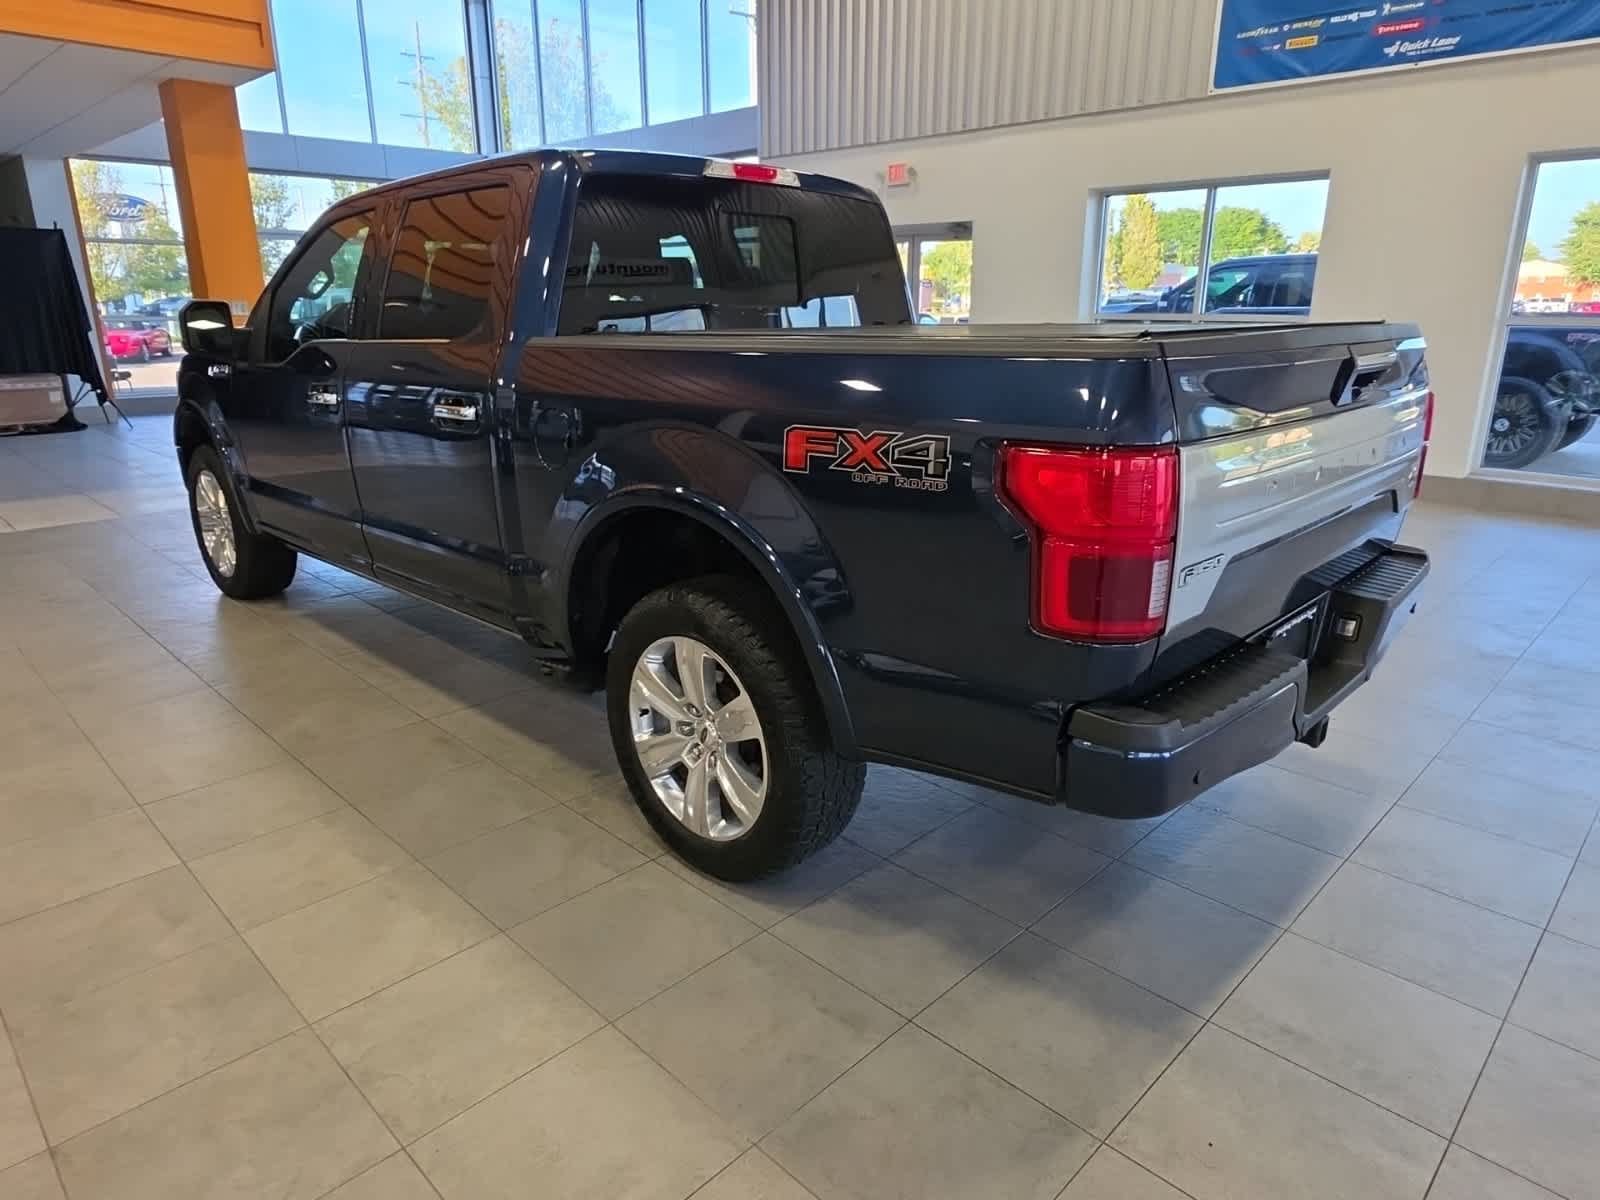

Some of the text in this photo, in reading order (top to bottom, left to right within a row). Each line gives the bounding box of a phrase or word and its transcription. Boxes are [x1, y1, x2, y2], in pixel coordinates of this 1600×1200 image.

[1399, 38, 1430, 52] Quick
[1430, 35, 1462, 48] Lane
[783, 424, 952, 481] FX4
[851, 472, 949, 492] OFF ROAD
